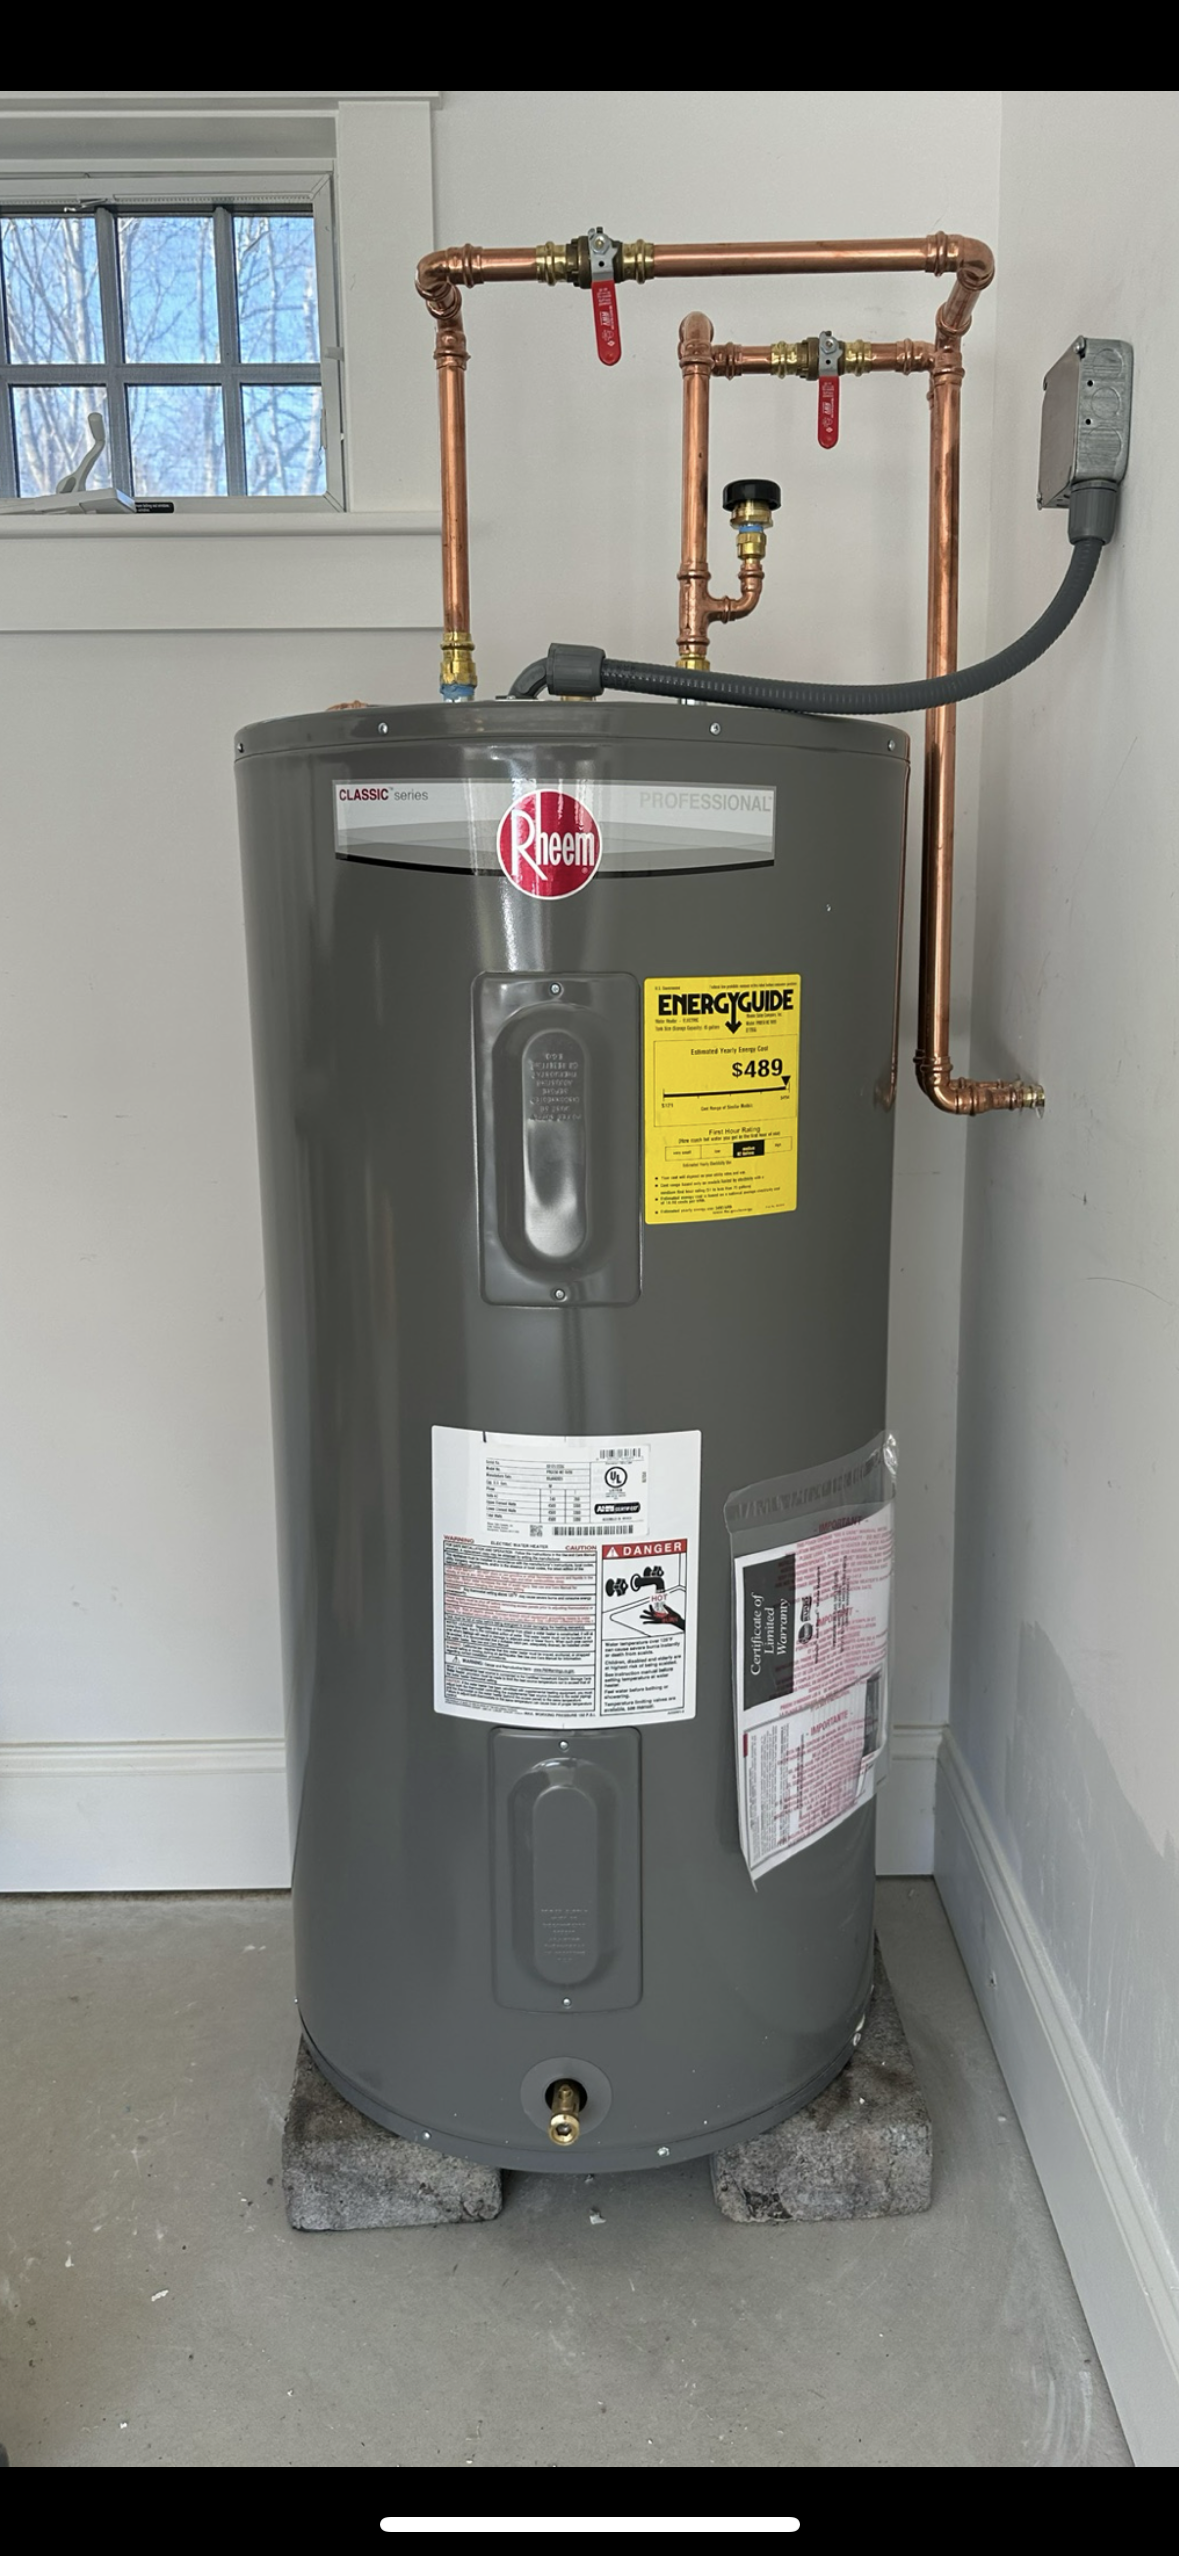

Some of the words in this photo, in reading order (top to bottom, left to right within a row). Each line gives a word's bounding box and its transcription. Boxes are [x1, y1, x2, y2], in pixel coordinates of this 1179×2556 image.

[339, 788, 389, 801] CLASSIC
[393, 789, 429, 801] series
[639, 791, 771, 812] PROFESSIONAL
[511, 790, 595, 881] Rheem
[658, 989, 794, 1016] ENERGYGUIDE
[732, 1058, 783, 1079] $489
[444, 1536, 475, 1544] WARNING
[623, 1542, 682, 1556] DANGER
[651, 1594, 667, 1602] HOT
[751, 1592, 765, 1608] of
[764, 1607, 775, 1655] Limited
[776, 1598, 790, 1655] Warranty
[750, 1610, 764, 1676] Certificate
[811, 1710, 848, 1736] IMPORTANTE
